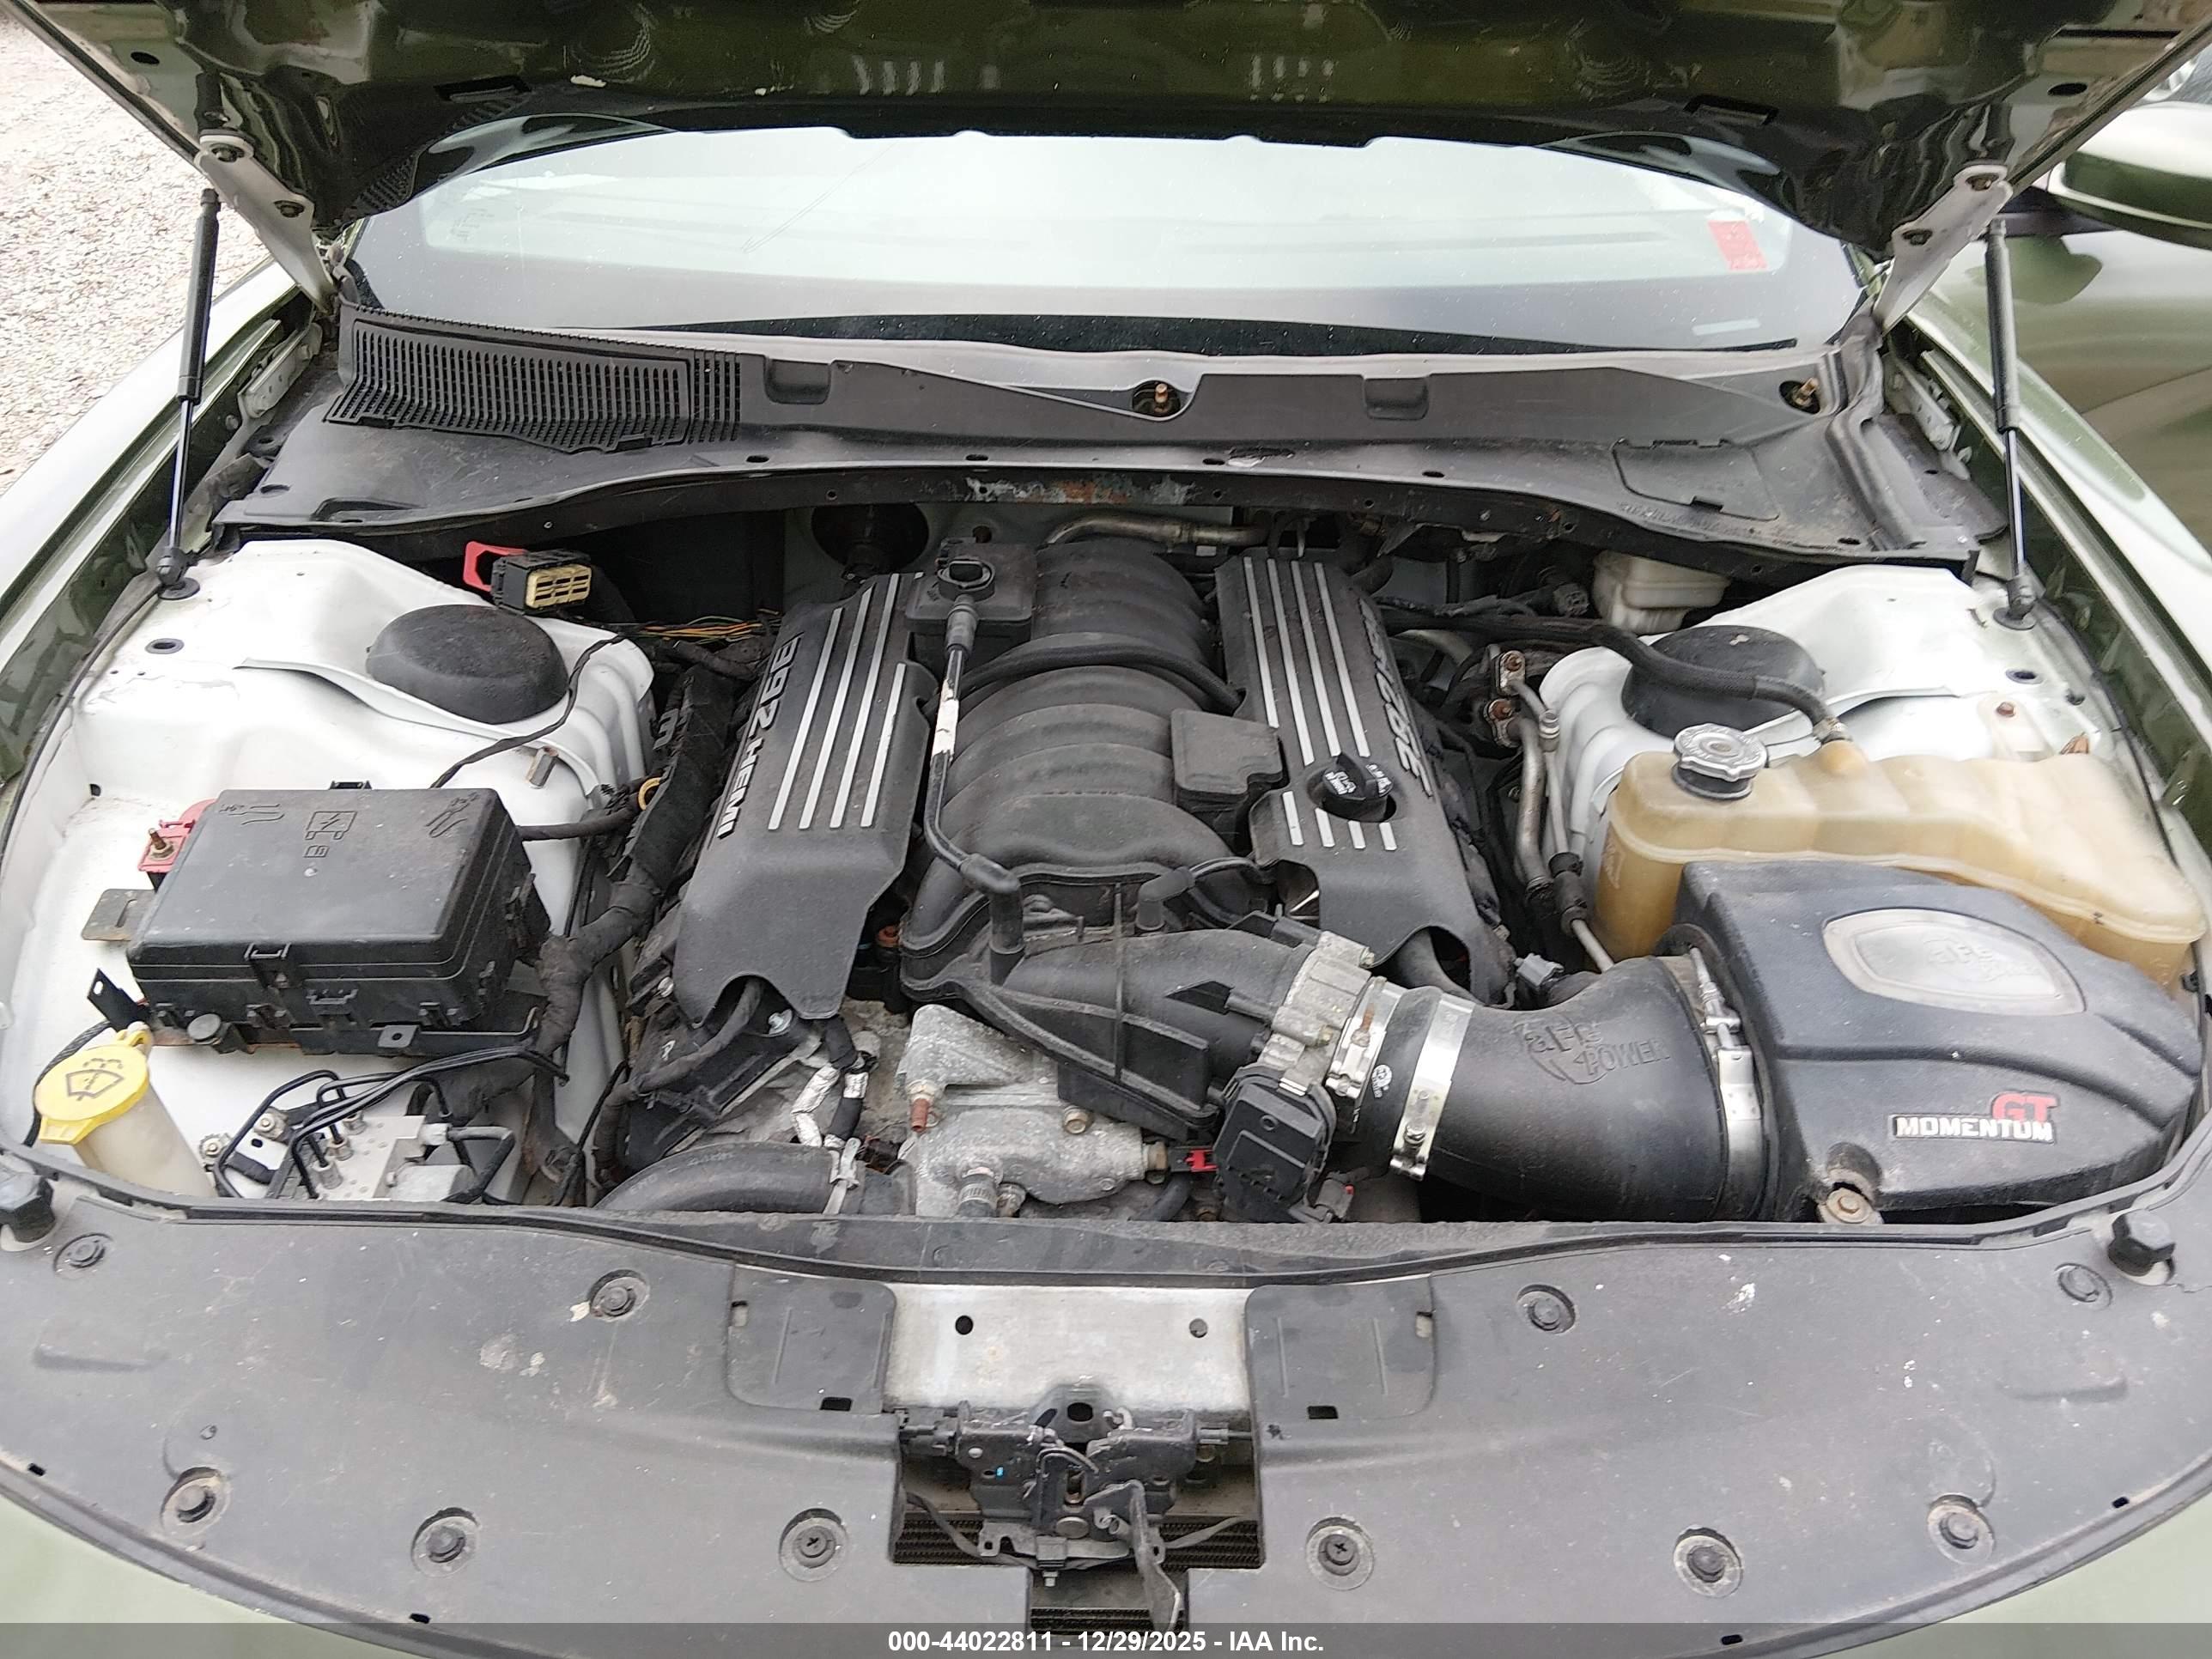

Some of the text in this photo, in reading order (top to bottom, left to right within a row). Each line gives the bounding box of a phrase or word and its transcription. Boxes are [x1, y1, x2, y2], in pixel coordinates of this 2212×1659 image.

[716, 635, 803, 839] 392 HEMI
[1376, 672, 1433, 797] 392
[1586, 1038, 1671, 1075] POWER
[1991, 1091, 2058, 1123] GT
[1895, 1116, 2054, 1142] MOMENTUM
